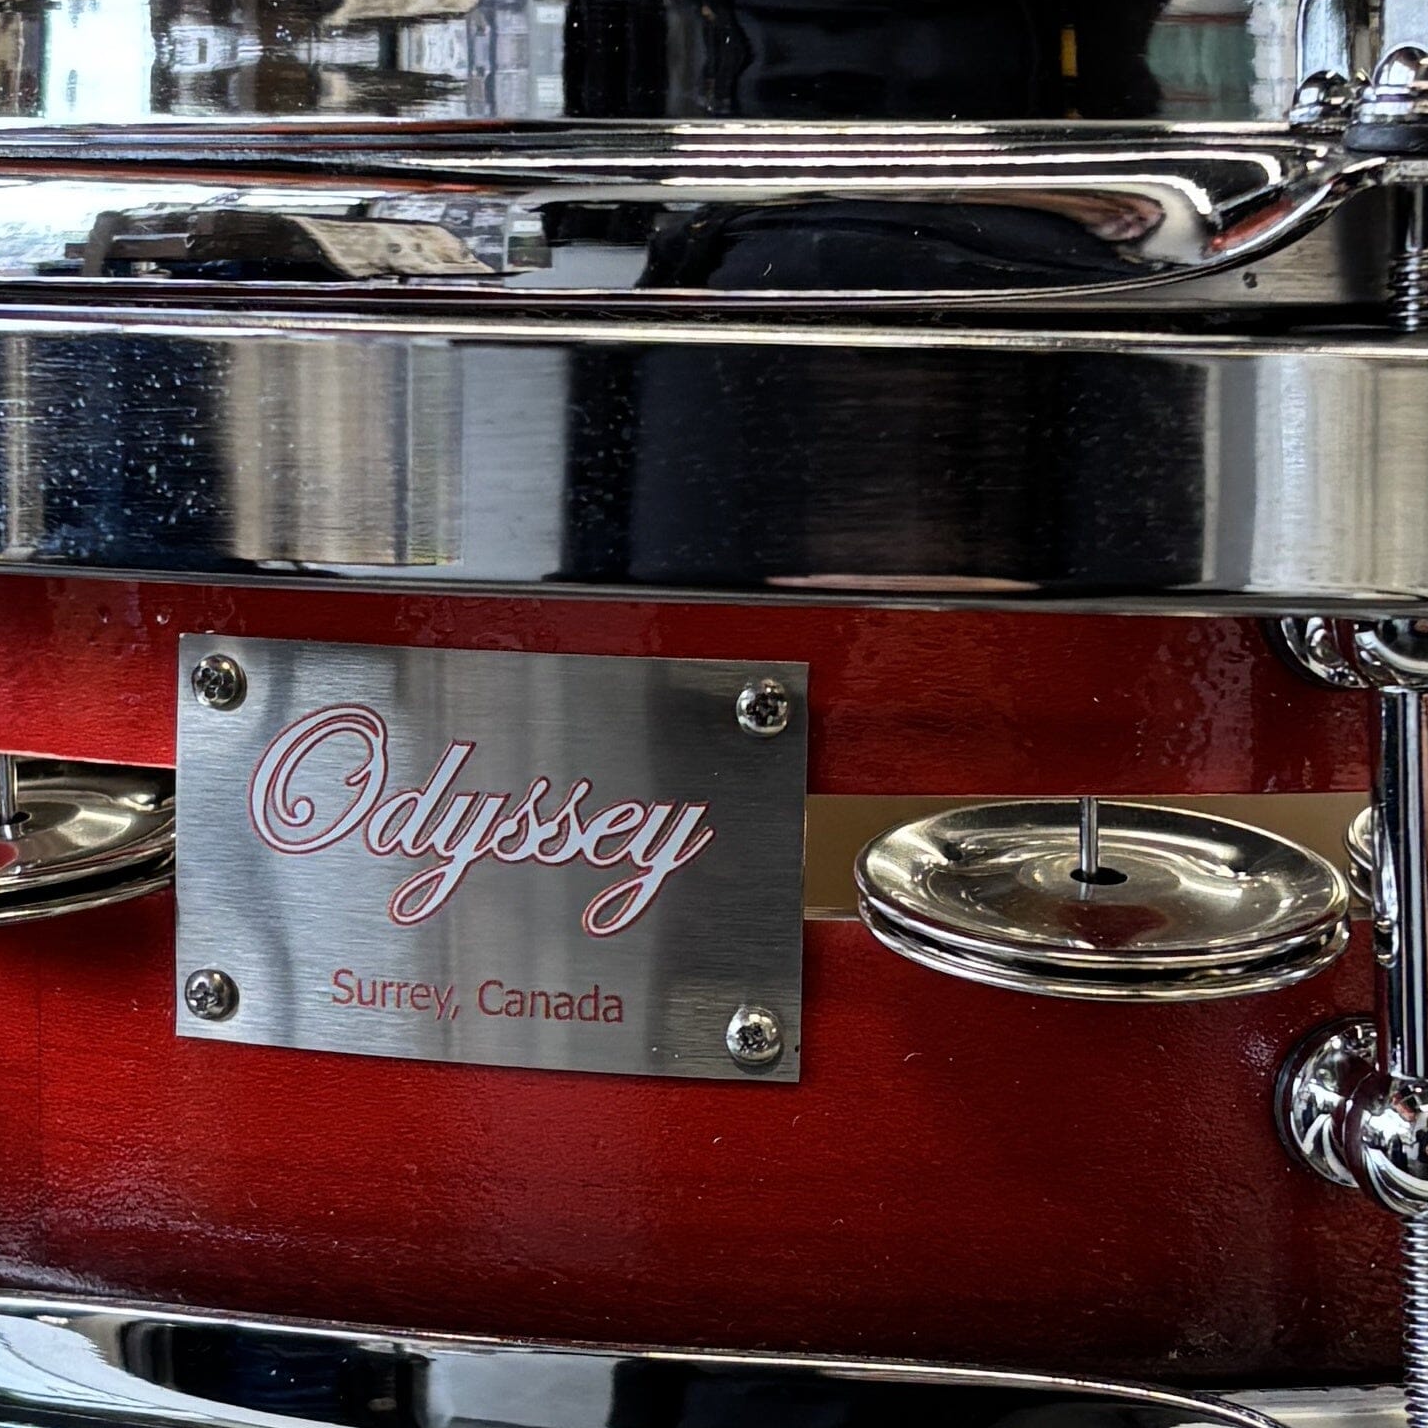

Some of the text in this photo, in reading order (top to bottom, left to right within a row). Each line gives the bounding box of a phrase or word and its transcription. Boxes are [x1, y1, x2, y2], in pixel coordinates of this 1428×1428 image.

[247, 702, 716, 939] Odyssey
[331, 968, 625, 1026] Surrey, Canada
